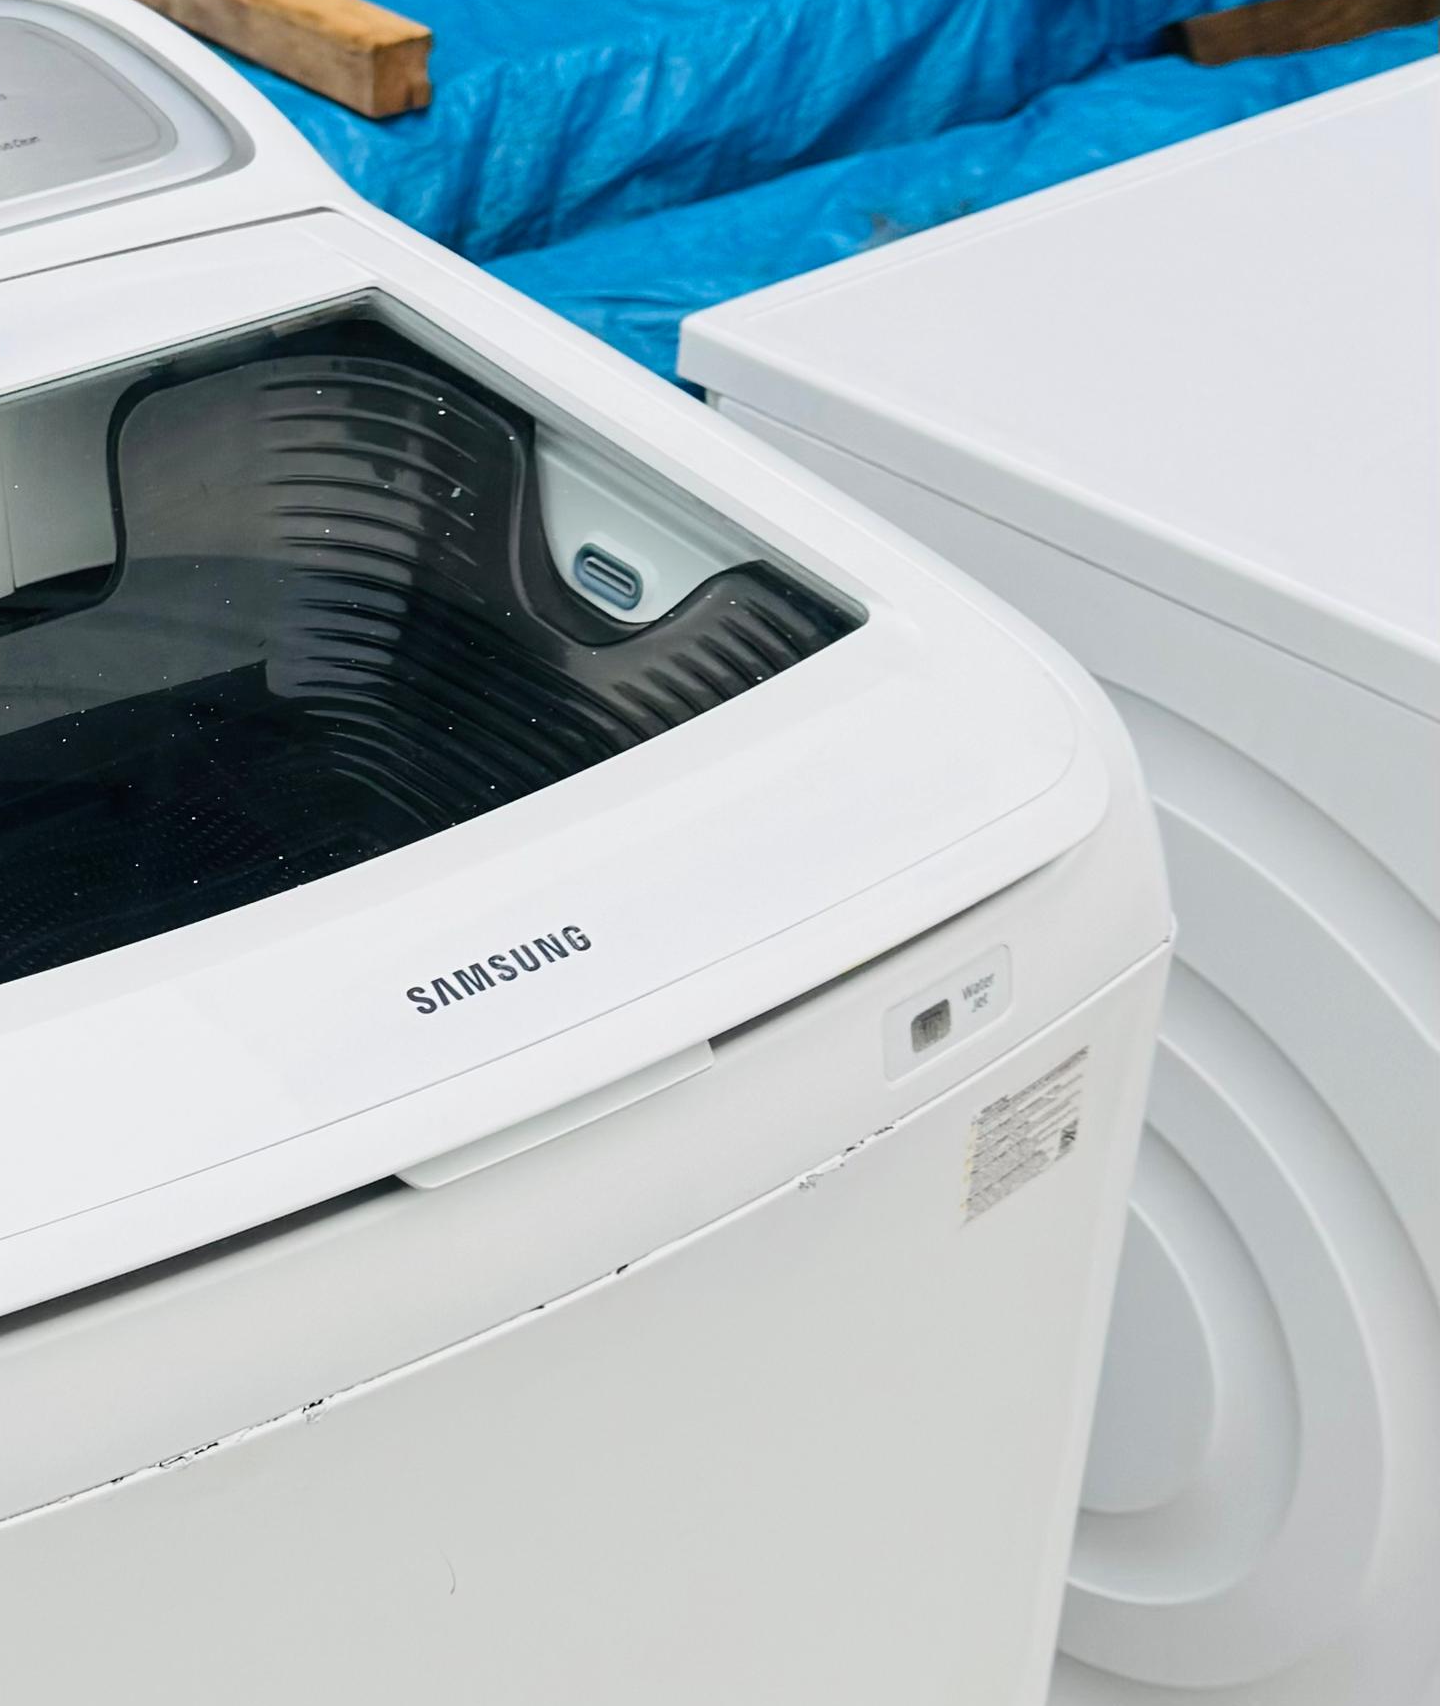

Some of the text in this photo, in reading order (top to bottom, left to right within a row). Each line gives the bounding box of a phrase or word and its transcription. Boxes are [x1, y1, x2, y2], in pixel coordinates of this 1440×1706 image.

[13, 136, 40, 148] Clean
[405, 923, 592, 1016] SAMSUNG
[961, 973, 995, 1001] Water
